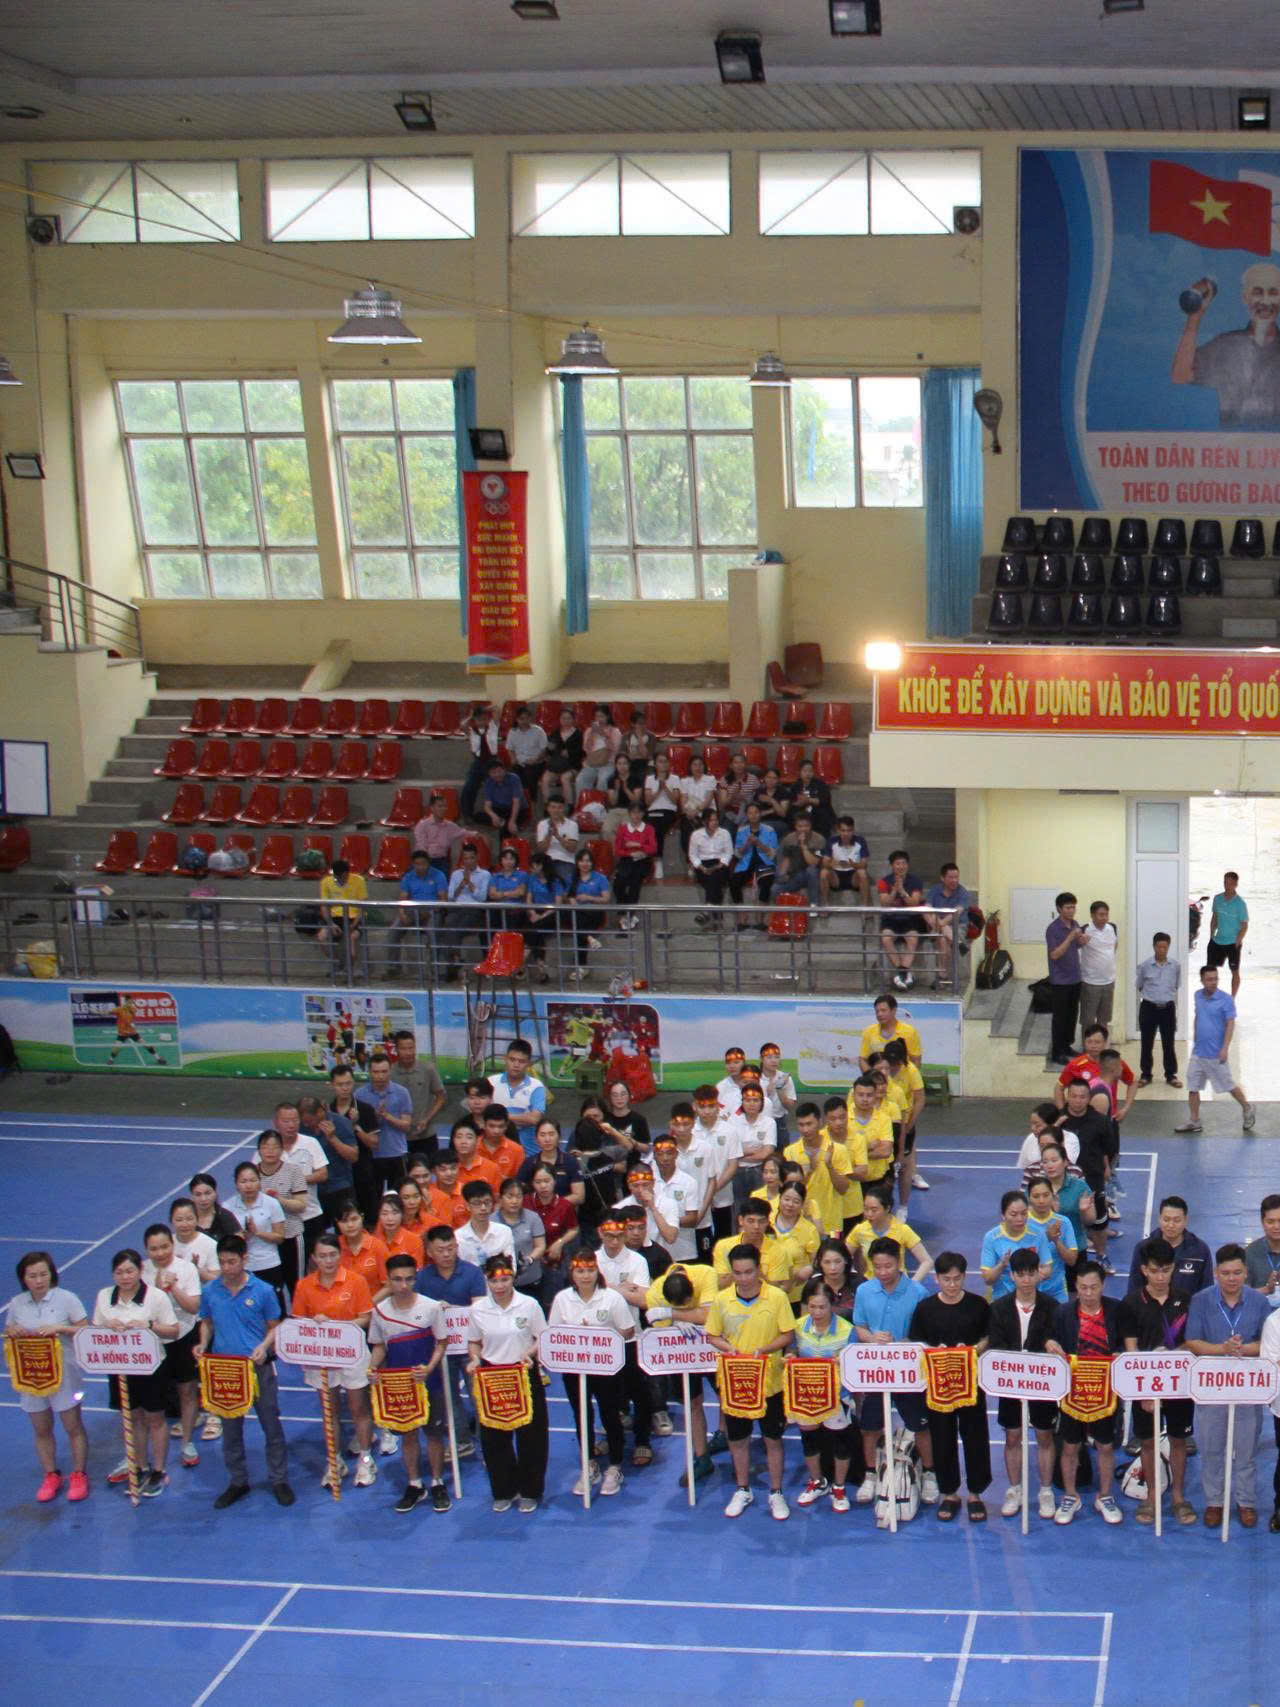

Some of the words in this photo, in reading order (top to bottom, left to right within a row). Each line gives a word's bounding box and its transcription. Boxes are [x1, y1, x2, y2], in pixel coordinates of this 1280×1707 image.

[1098, 442, 1148, 468] TOÀN
[1155, 442, 1195, 468] DÂN
[1122, 481, 1170, 503] THEO
[1176, 480, 1241, 504] GƯƠNG
[898, 666, 950, 715] KHỎE
[957, 664, 985, 715] ĐỂ
[989, 672, 1030, 716] XÂY
[1035, 676, 1091, 724] DỰNG
[1097, 673, 1123, 717] VÀ
[1129, 669, 1170, 718] BẢO
[1177, 674, 1201, 725] VỆ
[1207, 668, 1233, 718] TỔ
[299, 1323, 317, 1337] CÔNG
[318, 1327, 326, 1338] TY
[327, 1327, 342, 1339] MAY
[91, 1334, 119, 1347] TRẠM
[122, 1334, 128, 1345] Y
[130, 1332, 142, 1345] TẾ
[550, 1332, 576, 1345] CÔNG
[579, 1335, 589, 1346] TY
[592, 1336, 613, 1347] MAY
[658, 1335, 687, 1348] TRẠM
[102, 1349, 129, 1364] HỒNG
[131, 1352, 152, 1364] SƠN
[285, 1341, 301, 1354] XUẤT
[303, 1342, 320, 1356] KHẨU
[323, 1345, 333, 1360] ĐẠI
[550, 1349, 574, 1363] THÊU
[577, 1350, 591, 1363] MỸ
[594, 1351, 613, 1364] ĐỨC
[856, 1348, 878, 1360] CÂU
[880, 1350, 901, 1362] LẠC
[903, 1349, 917, 1362] BỘ
[651, 1352, 665, 1365] XÃ
[1125, 1358, 1148, 1370] CÂU
[1151, 1359, 1172, 1372] LẠC
[1175, 1358, 1190, 1372] BỘ
[858, 1365, 896, 1384] THÔN
[900, 1369, 917, 1384] 10
[992, 1359, 1025, 1376] BỆNH
[1028, 1361, 1057, 1378] VIỆN
[998, 1377, 1015, 1389] ĐA
[1018, 1379, 1050, 1391] KHOA
[1135, 1376, 1145, 1392] T
[1151, 1376, 1164, 1392] &
[1170, 1375, 1180, 1392] T
[1198, 1371, 1245, 1391] TRỌNG
[1249, 1369, 1270, 1387] TÀI
